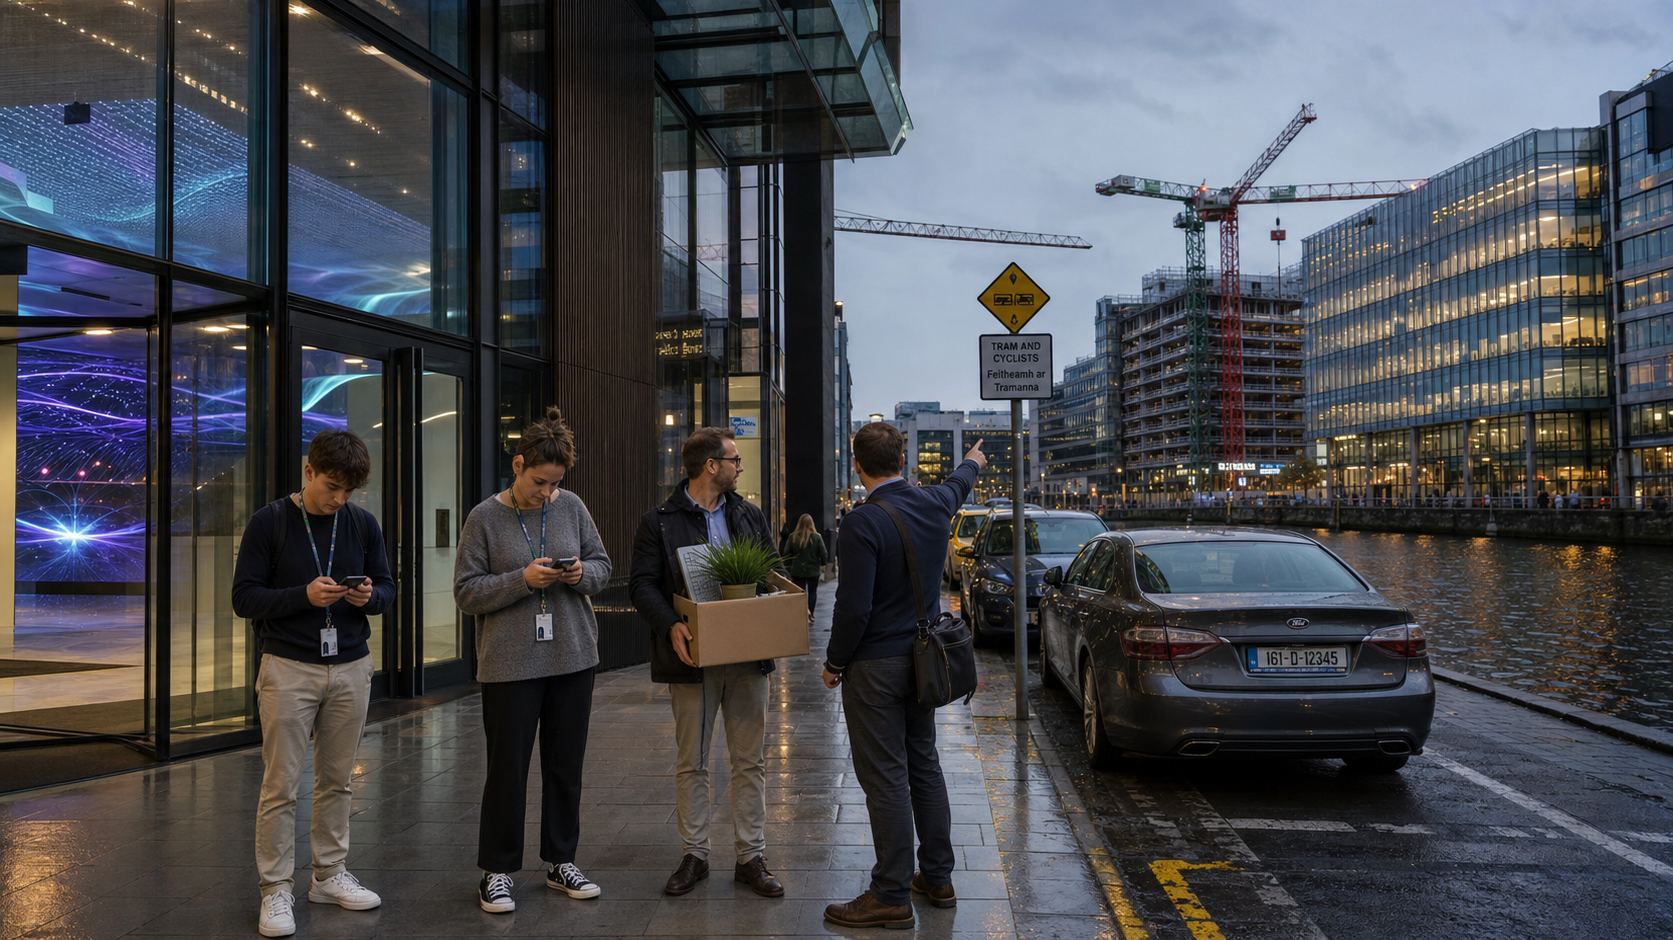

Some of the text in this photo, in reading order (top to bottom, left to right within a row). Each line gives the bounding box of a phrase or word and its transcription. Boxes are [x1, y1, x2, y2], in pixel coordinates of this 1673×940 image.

[991, 342, 1041, 351] TRAM AND
[993, 354, 1039, 363] CYCLISTS
[987, 369, 1034, 379] Feitheamh
[994, 383, 1039, 392] Tramanna
[1266, 651, 1338, 666] 161-D-12345
